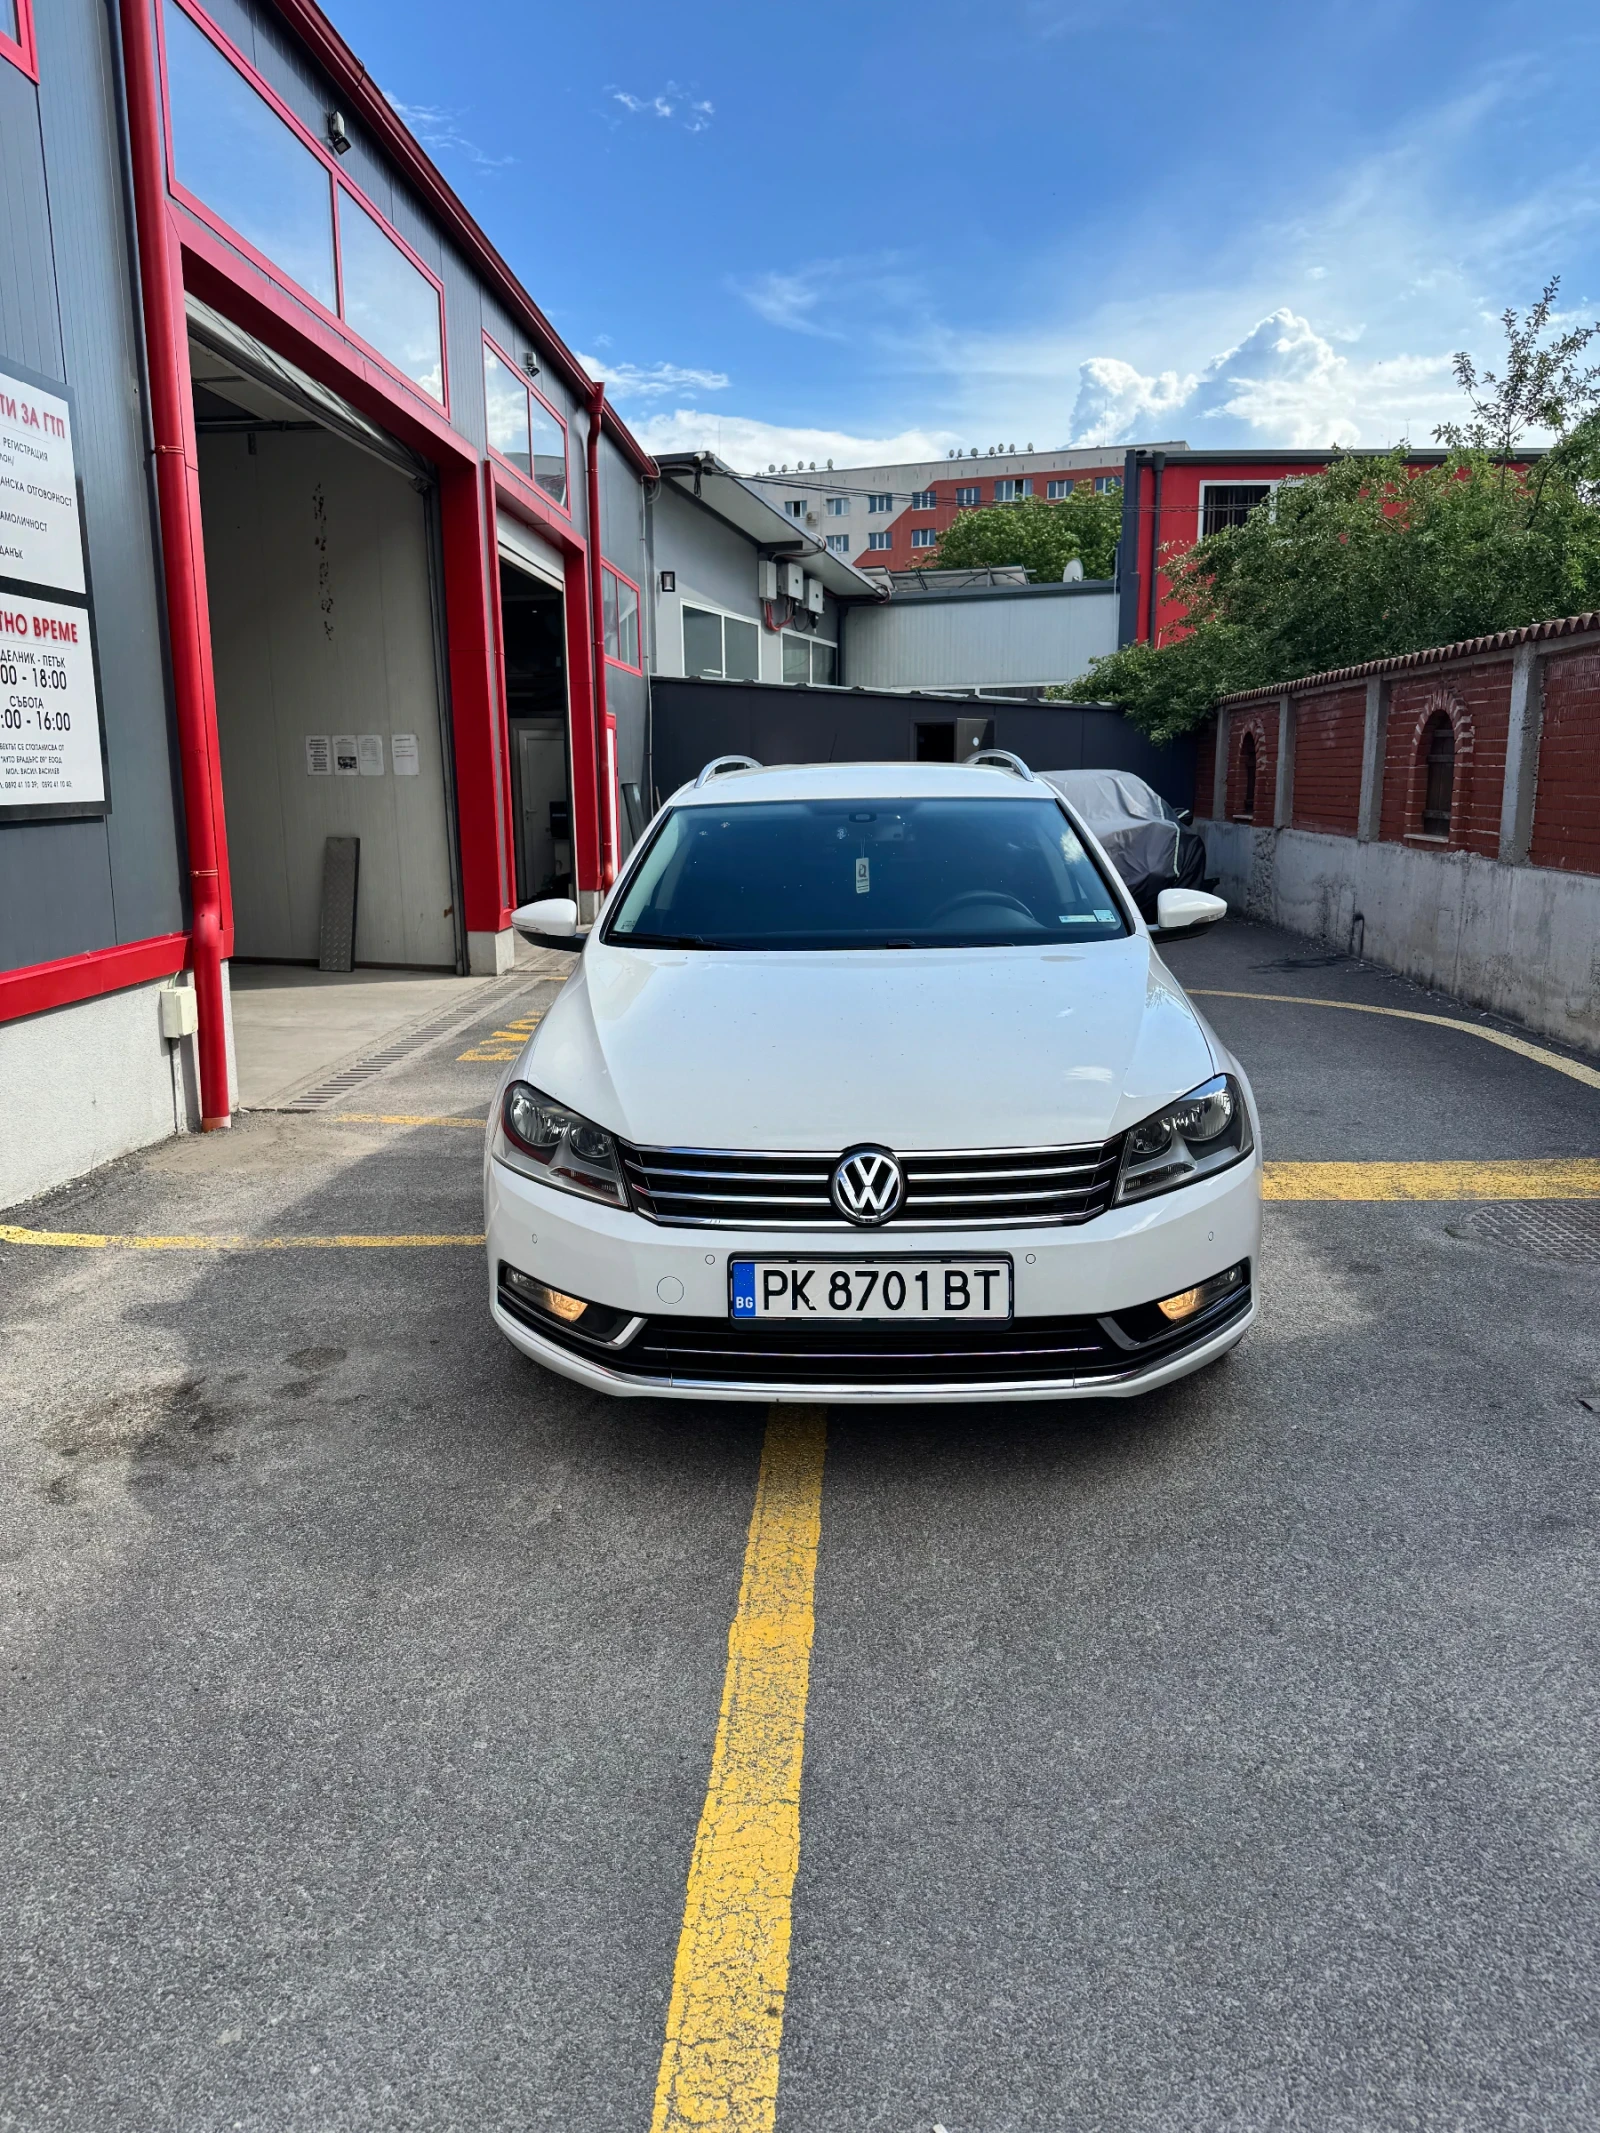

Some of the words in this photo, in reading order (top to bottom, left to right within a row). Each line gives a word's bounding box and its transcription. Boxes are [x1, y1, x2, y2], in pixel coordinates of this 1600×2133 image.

[21, 403, 40, 429] ЗА
[43, 412, 65, 439] ГТП
[2, 437, 48, 462] РЕГИСТРАЦИЯ
[27, 484, 72, 507] ОТГОВОРНОСТ
[33, 616, 78, 643] ВРЕМЕ
[42, 655, 66, 668] ПЕТЪК
[33, 668, 67, 690] 18:00
[9, 695, 44, 709] СЪБОТА
[37, 711, 71, 731] 16:00
[736, 1296, 753, 1309] BG
